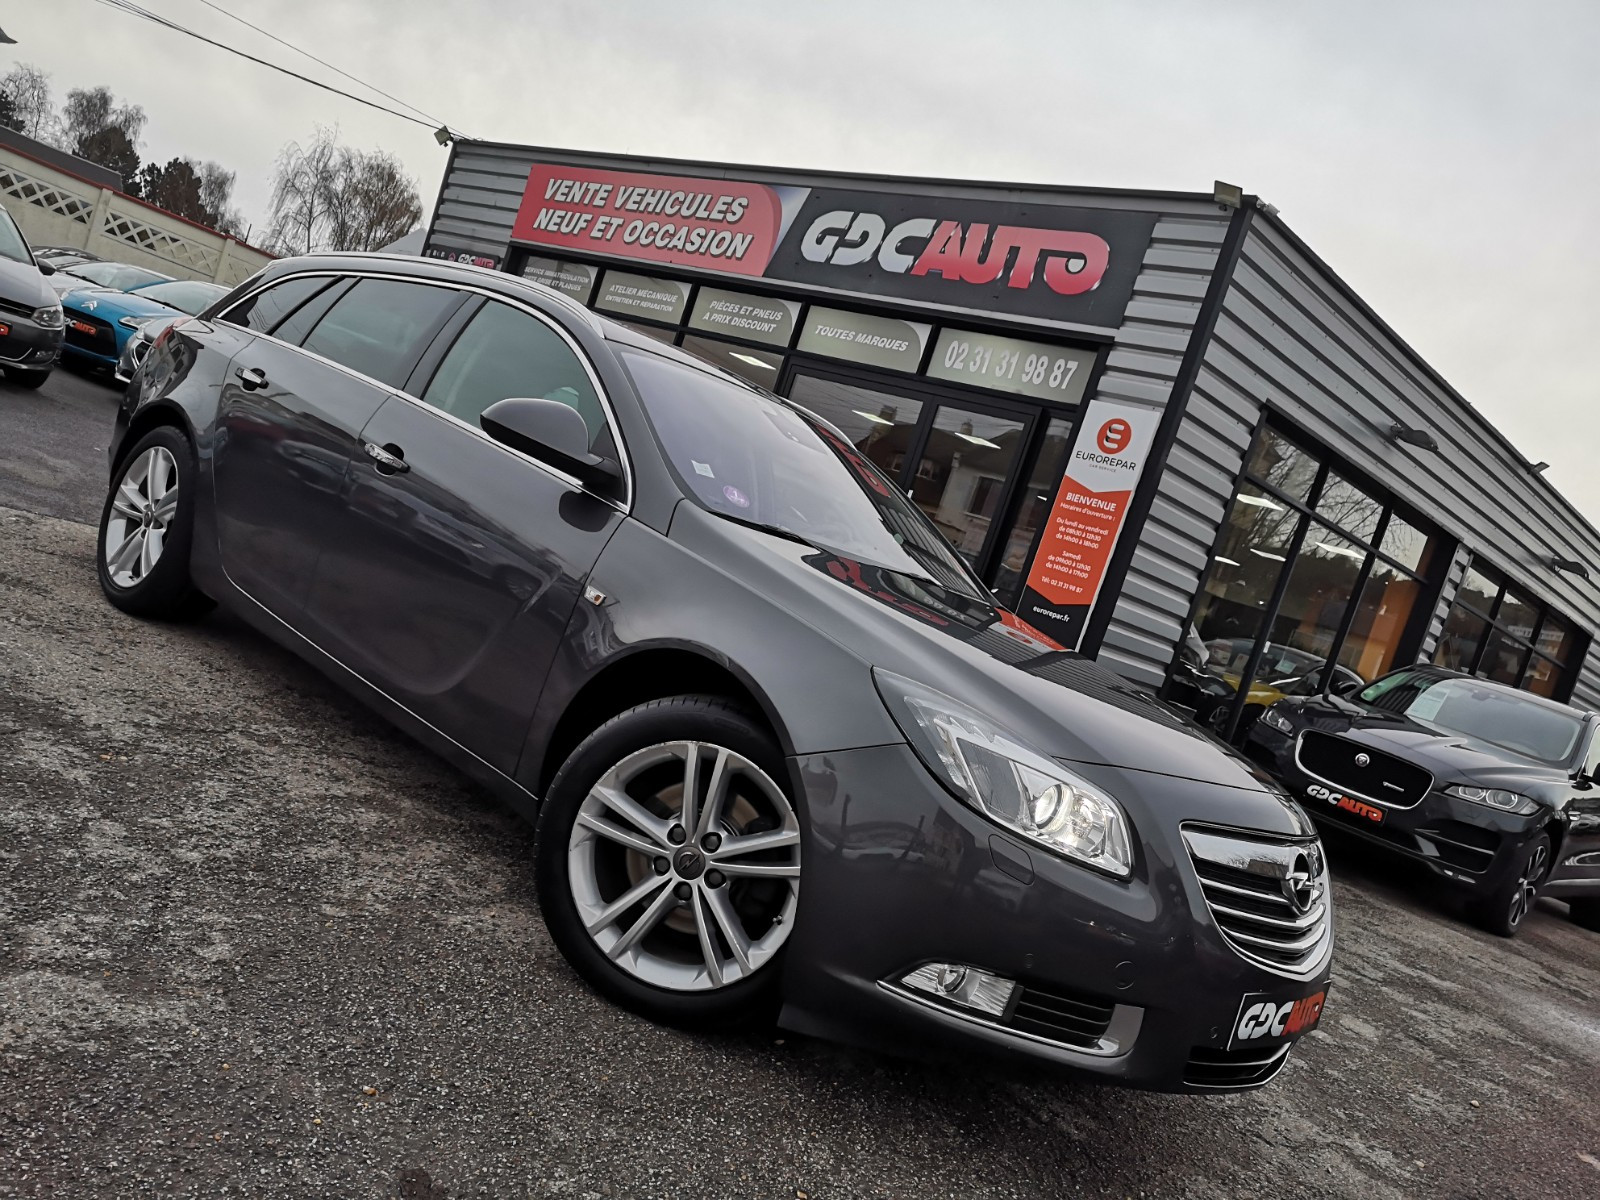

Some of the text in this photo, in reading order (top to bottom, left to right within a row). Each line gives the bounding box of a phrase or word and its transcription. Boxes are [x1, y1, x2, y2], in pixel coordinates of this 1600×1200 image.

[544, 178, 749, 223] VENTE VEHICULES
[532, 207, 753, 259] NEUF ET OCCASION
[524, 266, 545, 275] SERVICE
[557, 281, 581, 291] PLAQUES
[609, 284, 638, 296] ATELIER
[605, 295, 633, 305] ENTRETIEN
[709, 300, 783, 321] PIÈCES ET PNEUS
[710, 313, 732, 325] PRIX
[731, 317, 777, 333] DISCOUNT
[815, 325, 909, 352] TOUTES MARQUES
[944, 340, 1078, 390] 02 31 31 98 87
[1075, 450, 1137, 471] EUROREPAR
[1060, 502, 1082, 513] Horaires
[1082, 507, 1113, 520] d'ouverture
[1066, 492, 1117, 512] BIENVENUE
[1064, 518, 1078, 527] lundi
[1084, 524, 1109, 536] vendredi
[1063, 534, 1079, 544] 14h00
[1086, 533, 1101, 542] 12h30
[1062, 550, 1081, 560] Samedi
[1053, 564, 1068, 573] 14h00
[1073, 569, 1088, 579] 17h00
[1033, 605, 1070, 623] eurorepar.fr
